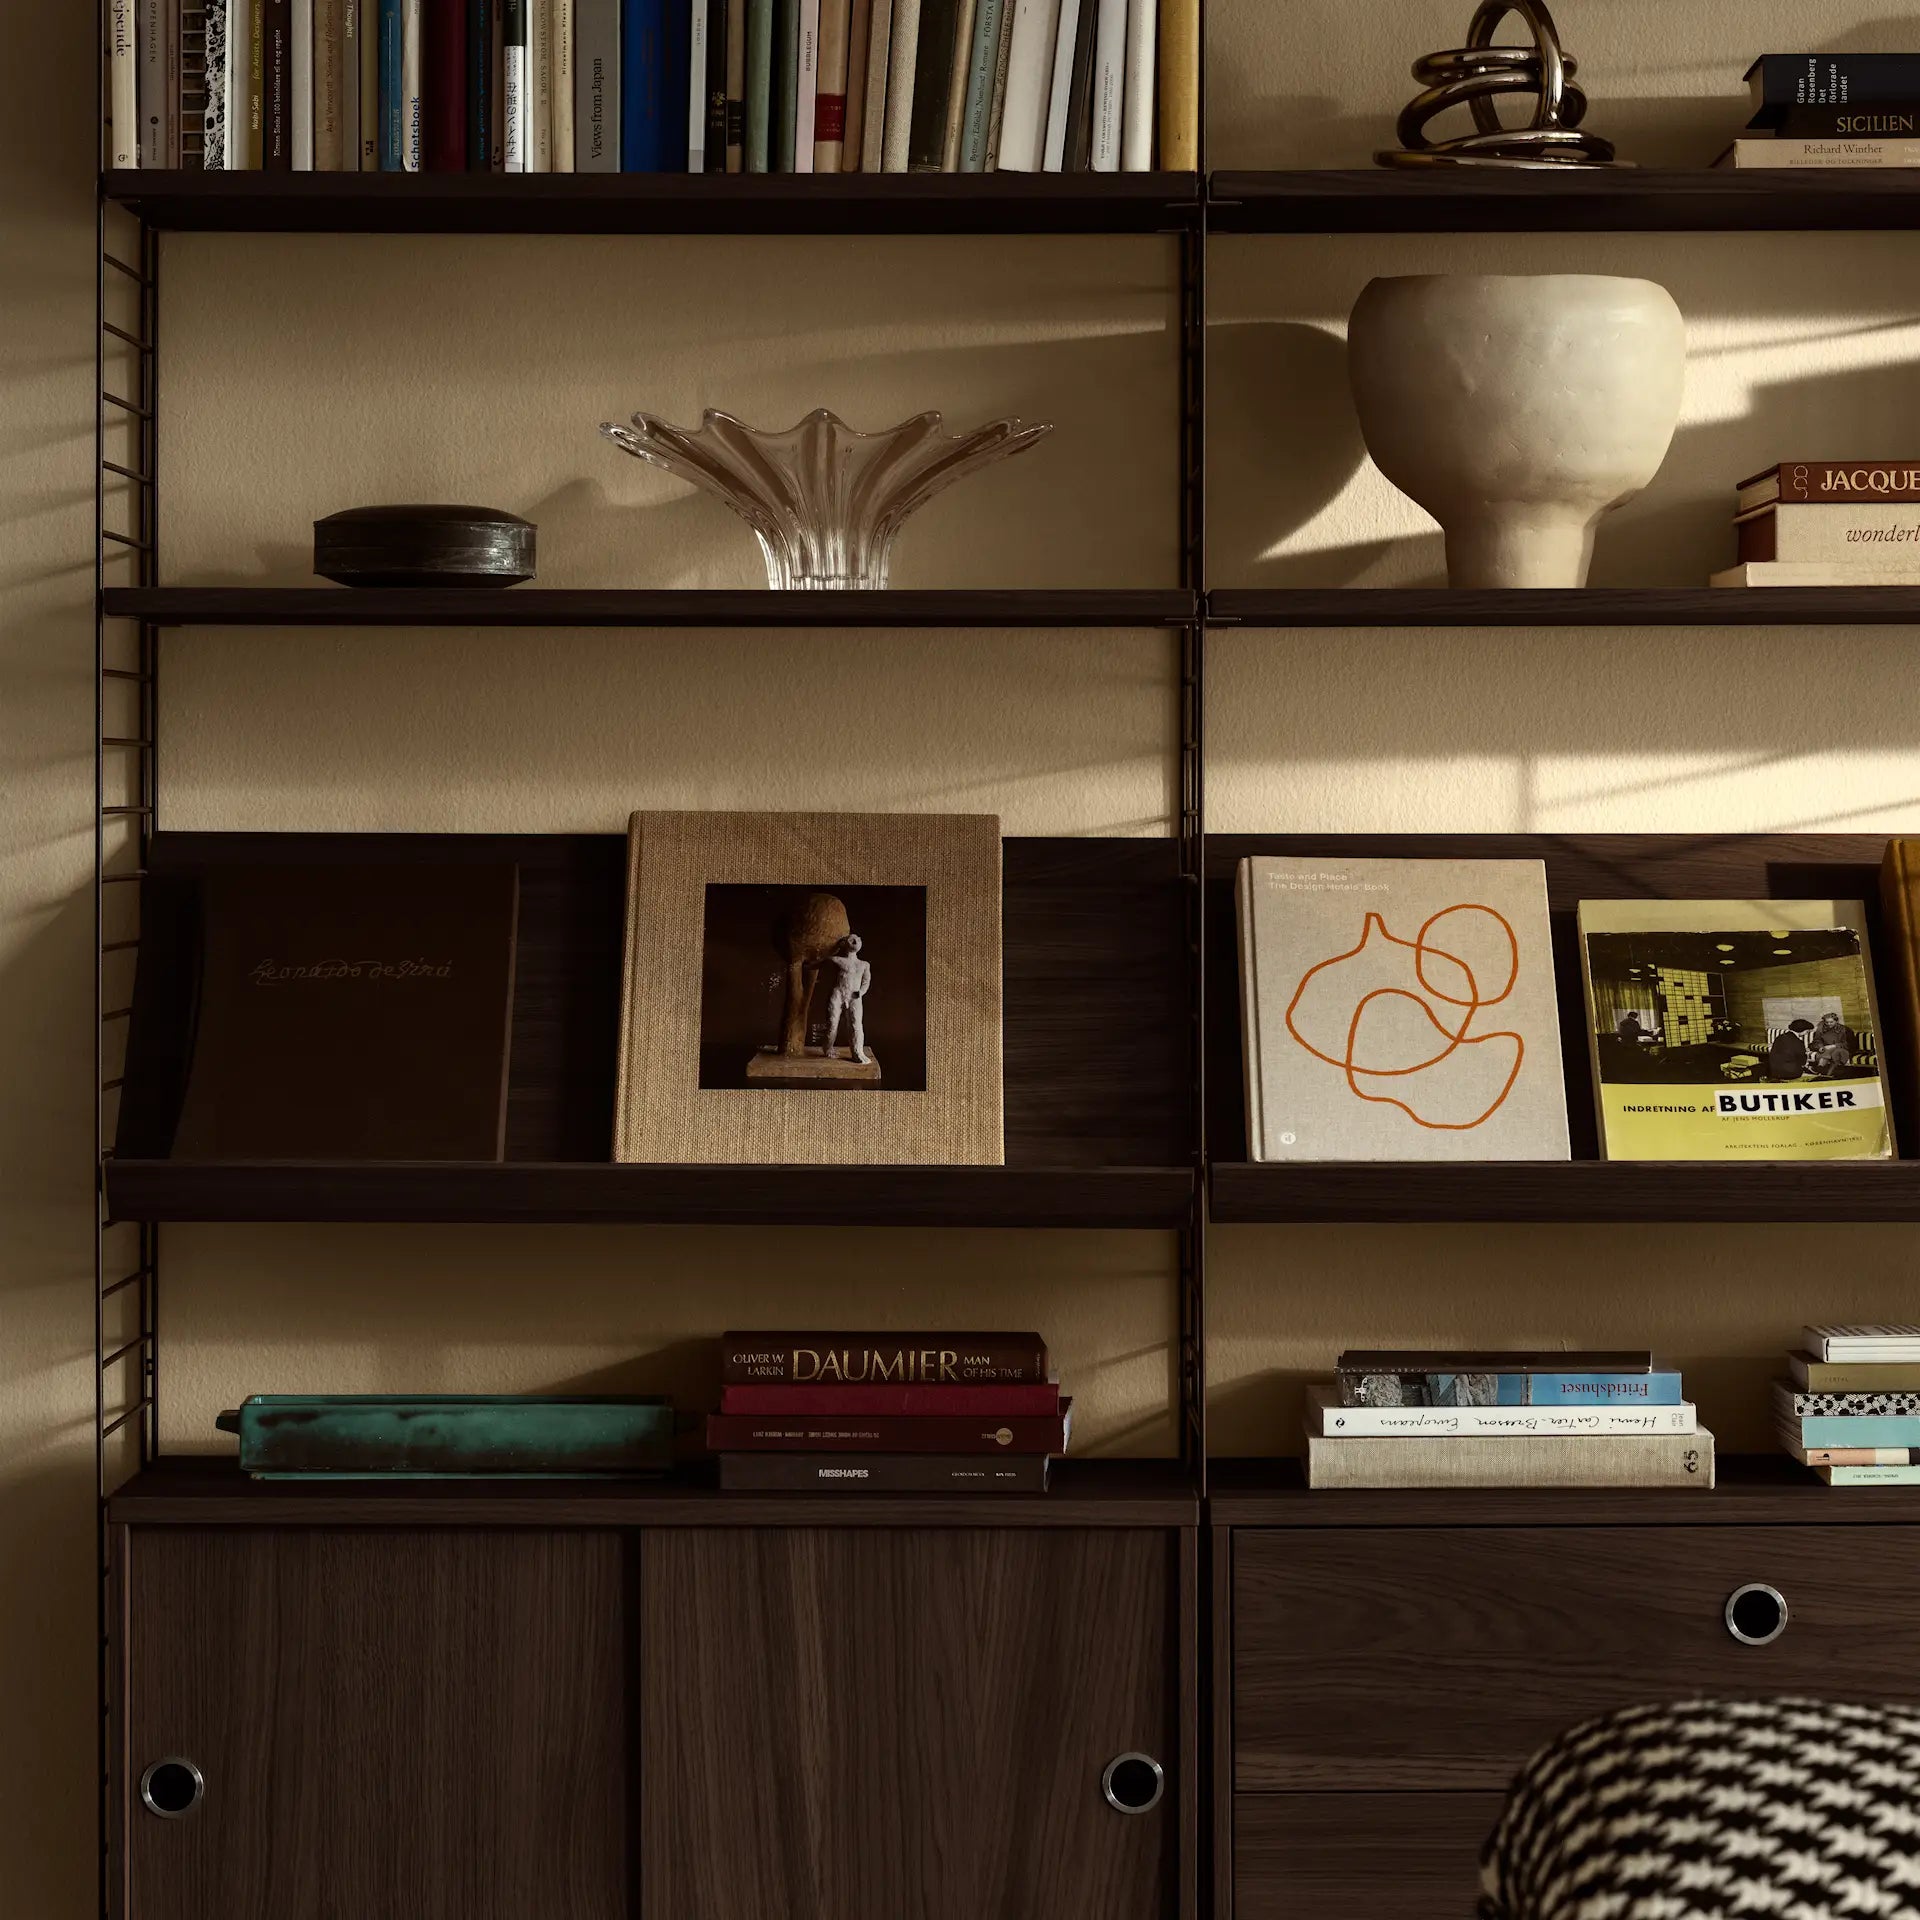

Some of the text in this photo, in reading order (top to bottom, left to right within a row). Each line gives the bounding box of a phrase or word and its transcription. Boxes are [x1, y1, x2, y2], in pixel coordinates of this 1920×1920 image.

[345, 4, 354, 38] Thoughts
[805, 31, 813, 72] BUBBLEGUM
[253, 68, 261, 79] for
[1807, 58, 1817, 103] Rosenberg
[1828, 63, 1837, 103] förlorade
[1796, 78, 1805, 103] Göran
[1818, 88, 1826, 103] Det
[1839, 75, 1848, 103] landet
[251, 95, 260, 130] Wabi-Sabi
[591, 57, 605, 159] Views from Japan
[410, 97, 420, 168] Schetsboek
[1836, 114, 1914, 133] SICILIEN
[1804, 143, 1882, 154] Richard Winther
[1820, 469, 1920, 494] JACQUE
[1846, 524, 1920, 543] wonderl
[1298, 872, 1317, 881] and
[1290, 882, 1325, 892] Design
[1364, 883, 1390, 891] Book
[1623, 1090, 1857, 1113] INDRETNING AF BUTIKER
[733, 1353, 770, 1364] OLIVER
[793, 1349, 959, 1382] DAUMIER
[964, 1355, 990, 1366] MAN
[747, 1365, 784, 1376] LARKIN
[963, 1367, 1023, 1379] OF HIS TIME
[1560, 1382, 1649, 1397] Fritidshuset
[1380, 1415, 1459, 1431] Europeans
[1609, 1416, 1657, 1429] Henri
[818, 1469, 869, 1478] MISSHAPES
